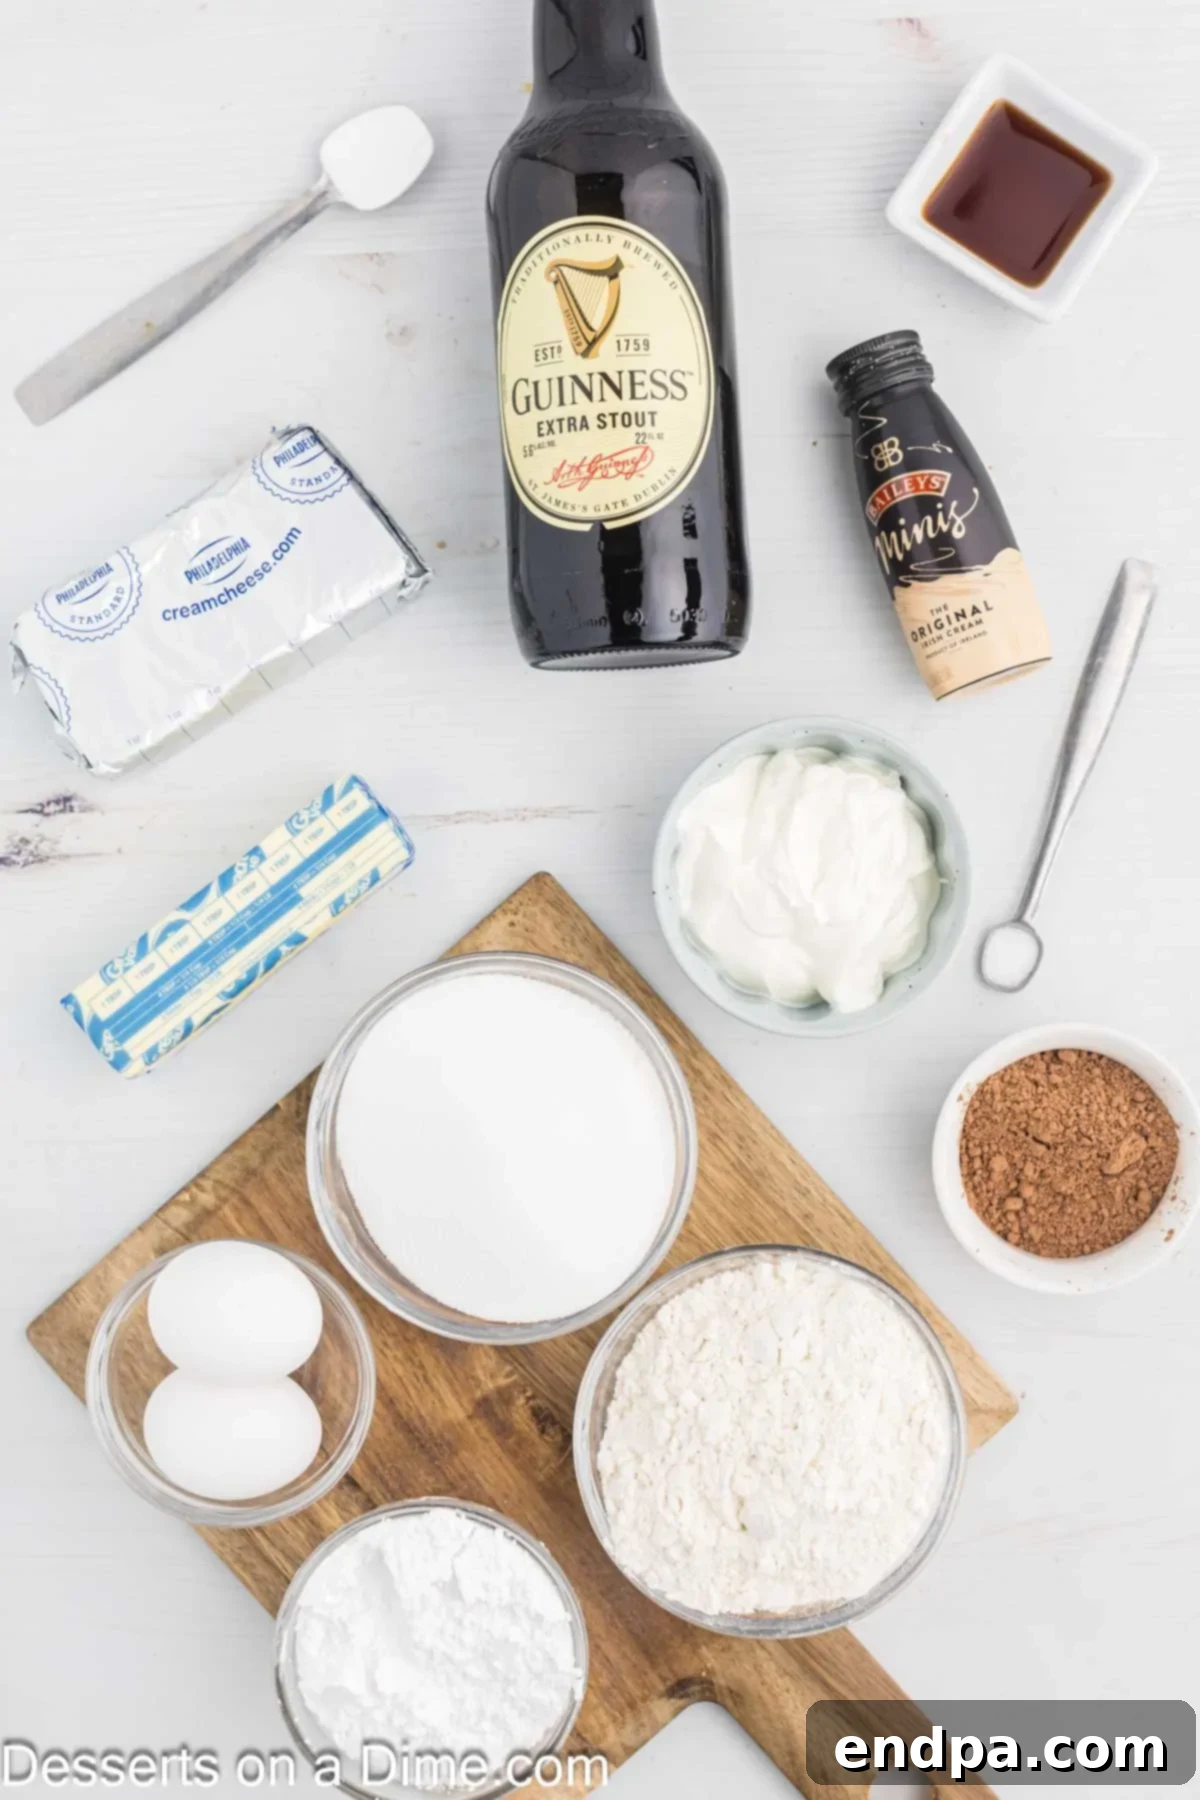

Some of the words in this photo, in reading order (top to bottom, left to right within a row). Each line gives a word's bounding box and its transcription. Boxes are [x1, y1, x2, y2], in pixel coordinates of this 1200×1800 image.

[511, 233, 615, 304] TRADITIONALLY
[622, 240, 678, 291] BREWED
[616, 338, 650, 352] 1759
[512, 368, 688, 416] GUINNESS
[537, 415, 590, 438] EXTRA
[596, 411, 658, 430] STOUT
[542, 493, 588, 513] JAMES'S
[594, 498, 630, 513] GATE
[634, 467, 678, 504] DUBLIN
[869, 475, 943, 518] BAILEYS
[875, 487, 979, 575] Minis
[162, 526, 302, 621] creamcheese.com
[184, 536, 251, 585] PHILADELPHIA
[56, 562, 114, 604] PHILADELPHIA
[70, 586, 125, 625] STANDARD
[911, 600, 994, 643] ORIGINAL
[930, 602, 949, 616] THE
[921, 634, 944, 650] IRISH
[946, 618, 984, 638] CREAM
